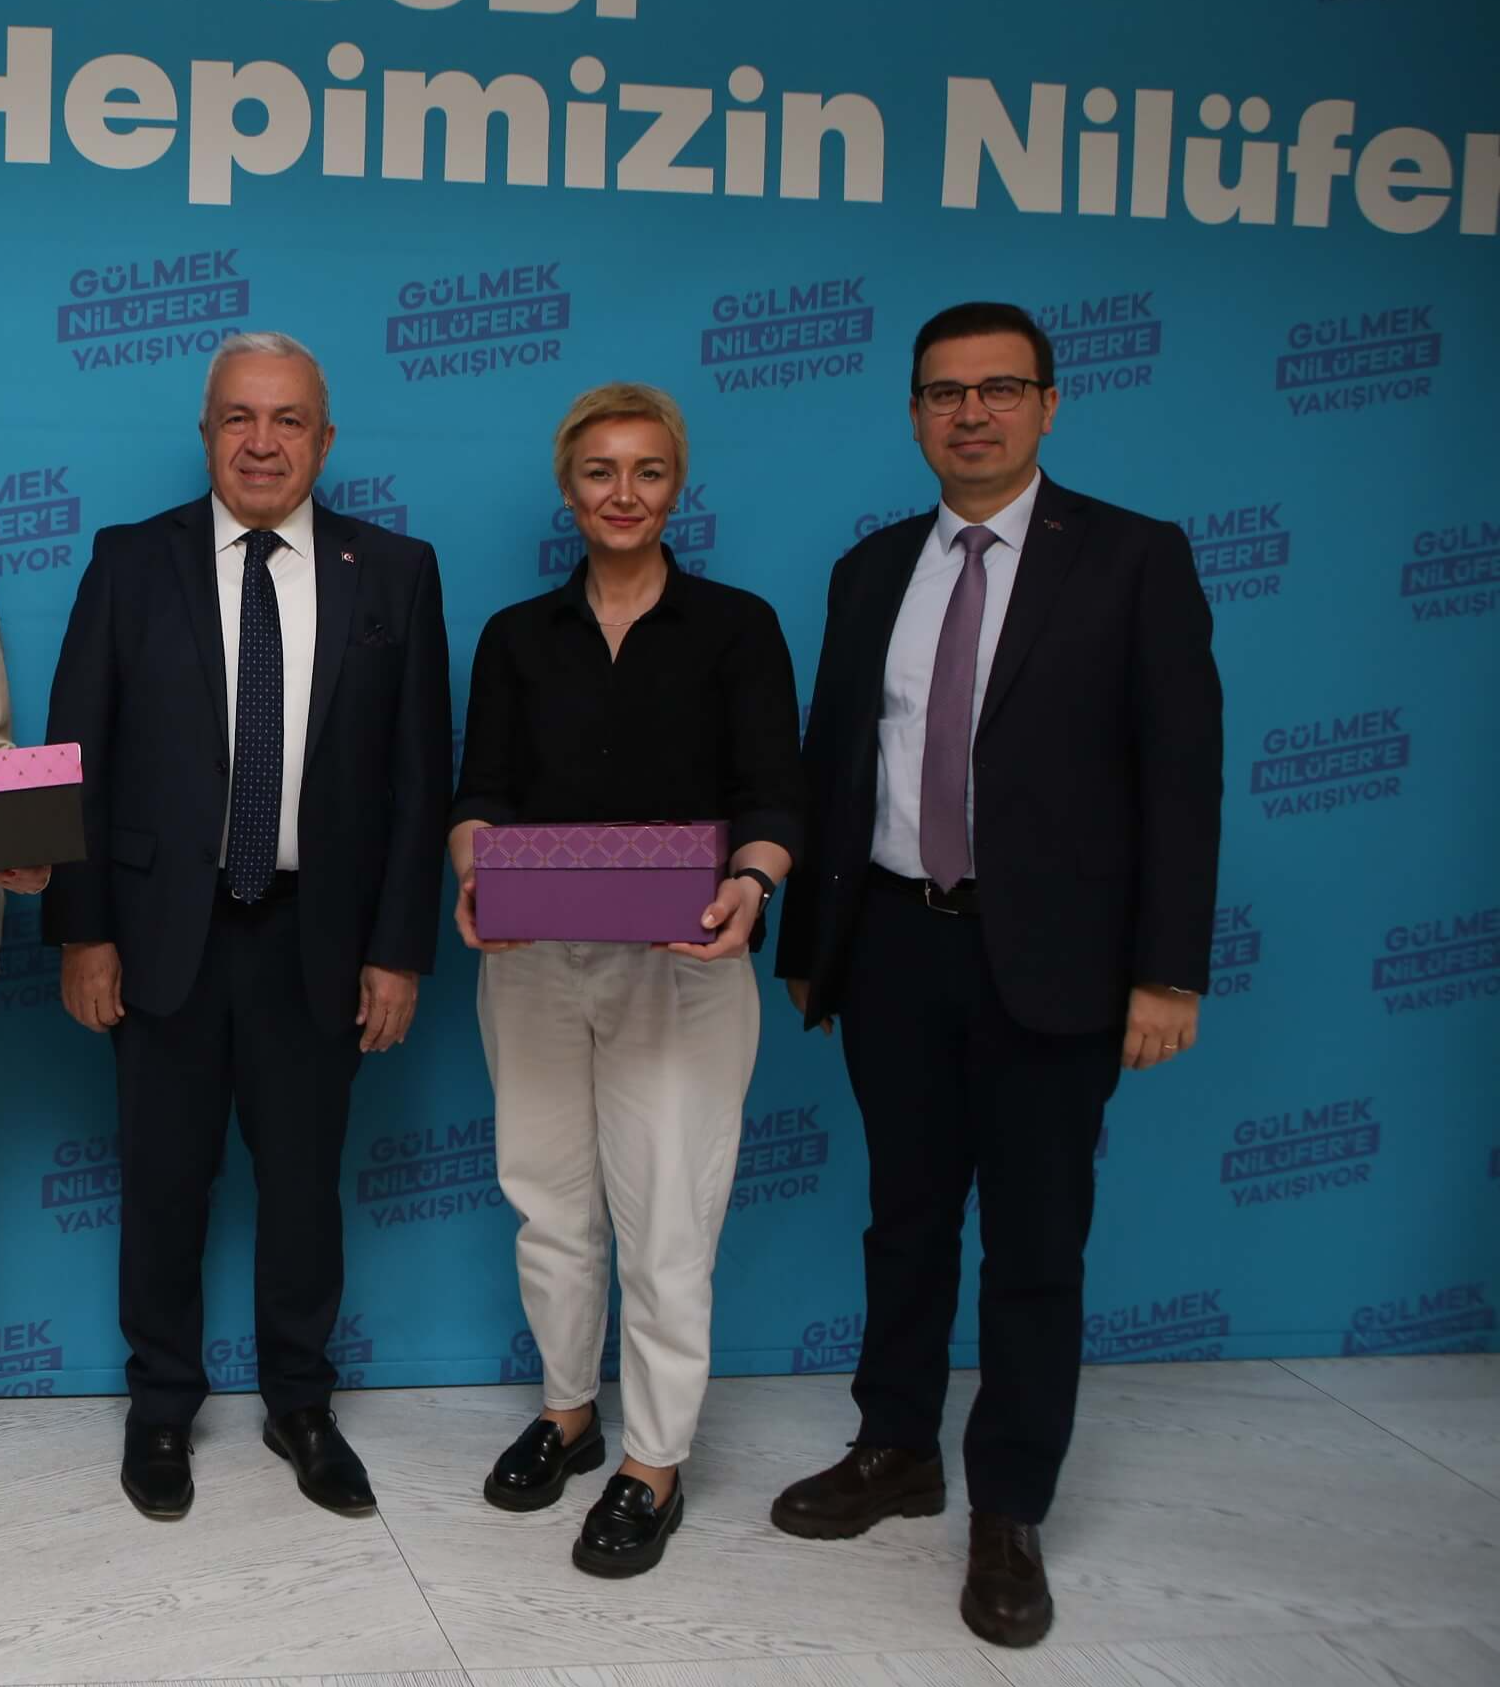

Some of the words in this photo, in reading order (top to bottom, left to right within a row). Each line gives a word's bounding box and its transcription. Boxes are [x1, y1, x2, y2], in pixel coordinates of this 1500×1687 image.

[942, 76, 1500, 236] Nilüfer
[69, 249, 238, 299] GÜLMEK
[398, 262, 561, 311] GÜLMEK
[713, 277, 866, 324] GÜLMEK
[1037, 290, 1153, 331] ÜLMEK
[1288, 305, 1434, 350] GÜLMEK
[400, 338, 561, 382] YAKIŞIYOR
[714, 352, 864, 393] YAKIŞIYOR
[1060, 364, 1153, 400] IŞIYOR
[1287, 377, 1431, 416] YAKIŞIYOR
[1263, 707, 1402, 754] GÜLMEK
[1262, 777, 1401, 819] YAKIŞIYOR
[369, 1116, 495, 1162] GÜLME
[1234, 1097, 1373, 1145] GÜLMEK
